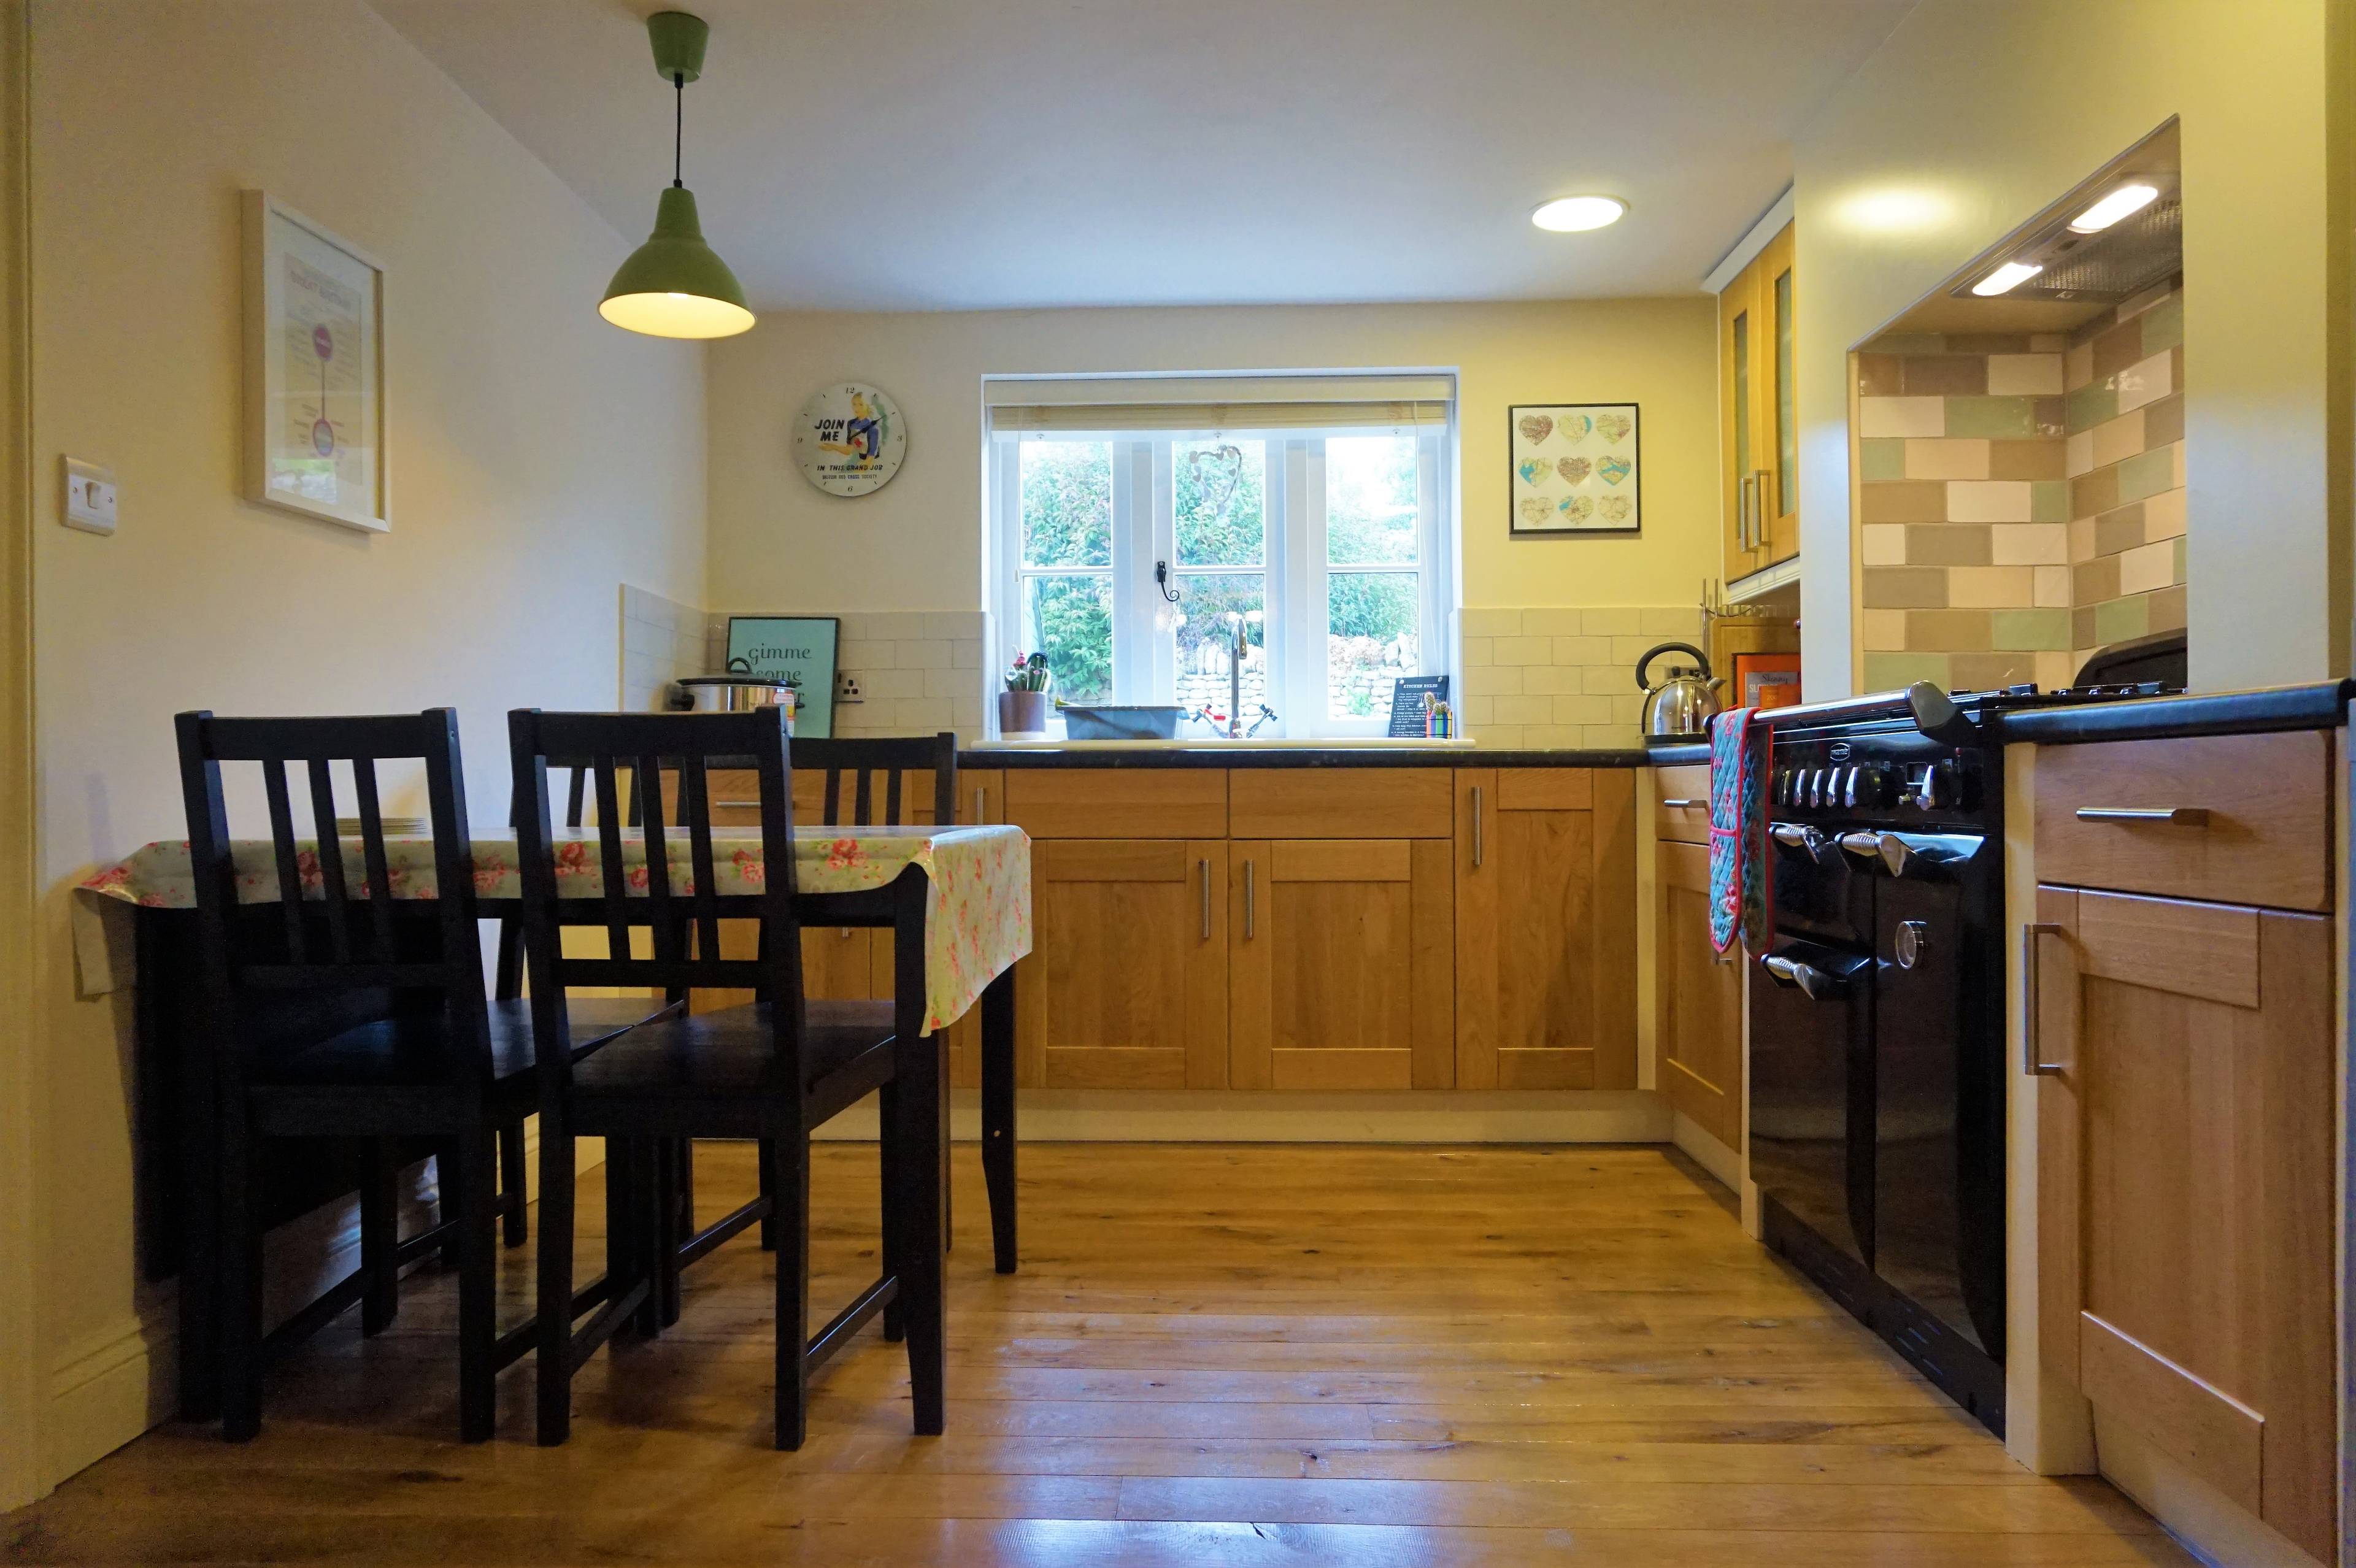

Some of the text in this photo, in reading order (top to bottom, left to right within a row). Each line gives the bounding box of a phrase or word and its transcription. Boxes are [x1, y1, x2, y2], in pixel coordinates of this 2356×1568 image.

[814, 419, 845, 430] JOIN
[820, 431, 840, 442] ME
[749, 643, 812, 666] gimme
